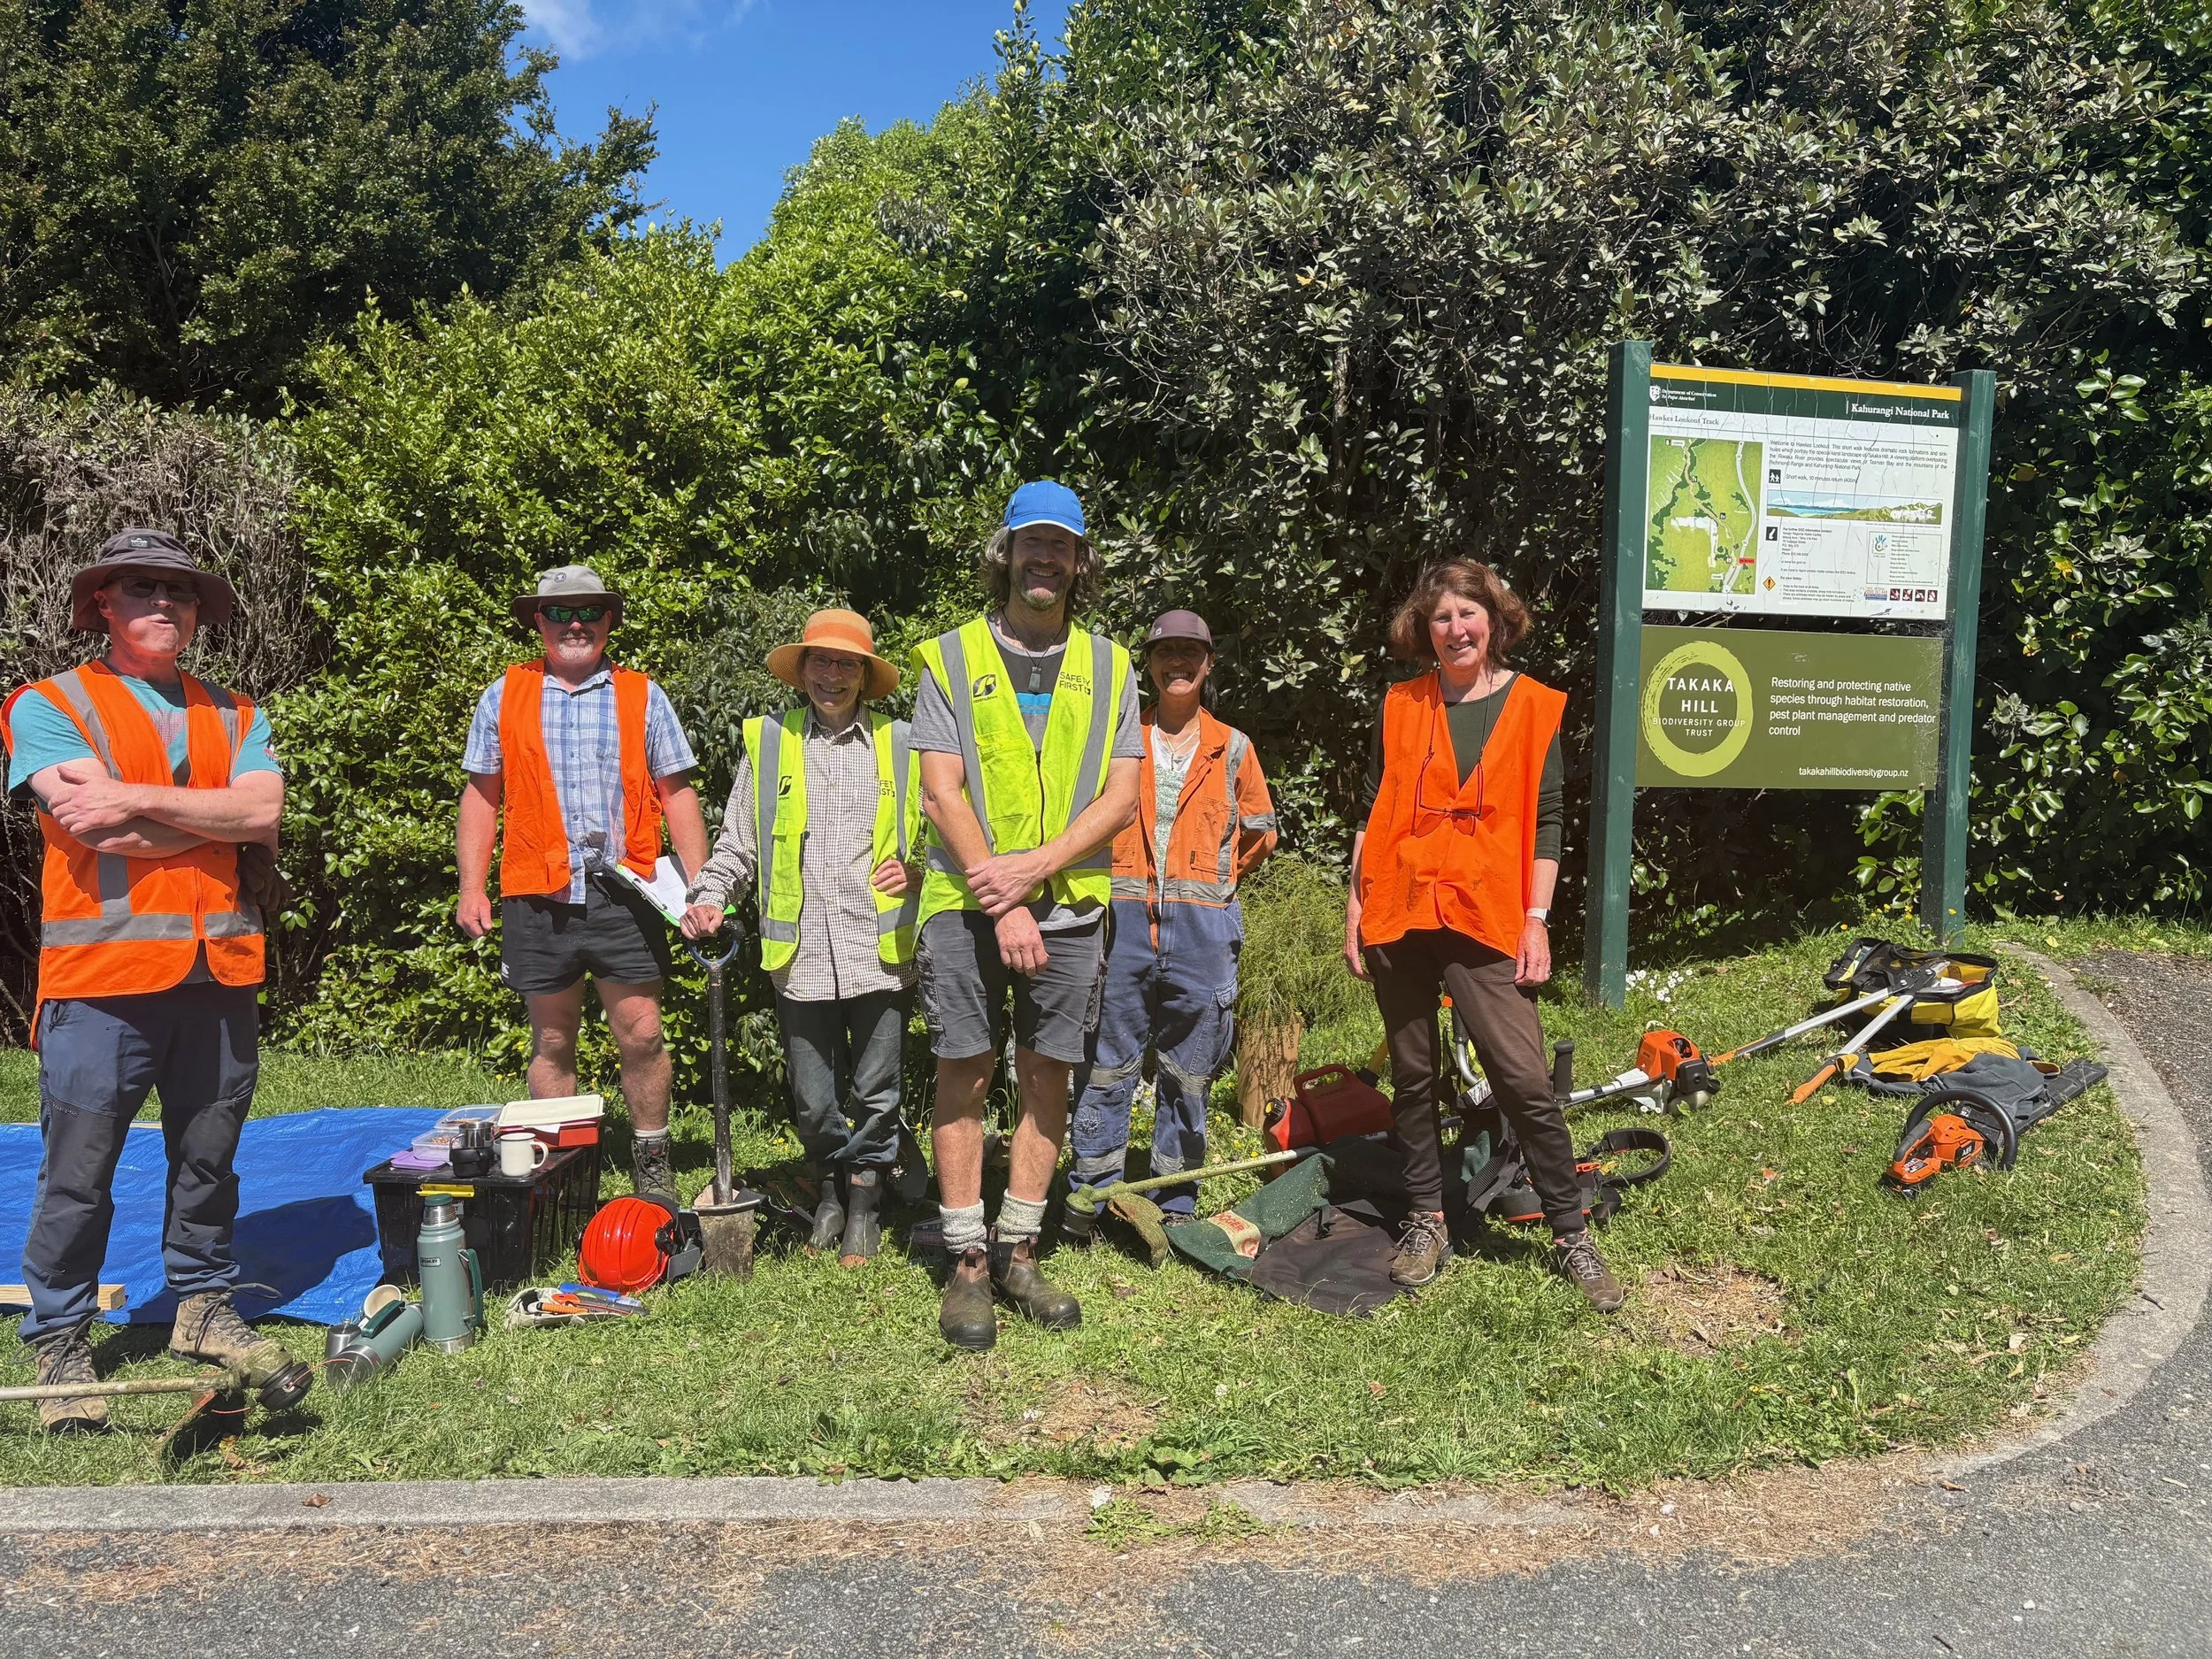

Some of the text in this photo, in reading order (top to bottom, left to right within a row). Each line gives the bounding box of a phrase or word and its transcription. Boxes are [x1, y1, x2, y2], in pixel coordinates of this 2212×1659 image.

[1851, 403, 1950, 419] Kahurangi National Park
[1675, 415, 1700, 424] Lookout
[1060, 671, 1091, 686] SAFETY
[1667, 678, 1734, 692] TAKAKA
[1771, 677, 1911, 693] Restoring and protecting native
[1059, 680, 1083, 692] FIRST
[1681, 700, 1718, 713] HILL
[1770, 695, 1929, 709] species through habitat restoration,
[1653, 718, 1714, 726] BIODIVERSITY
[1770, 710, 1936, 725] pest plant management and predator
[1769, 726, 1800, 736] control
[1799, 767, 1909, 779] takakahillbiodiversitygroup.nz
